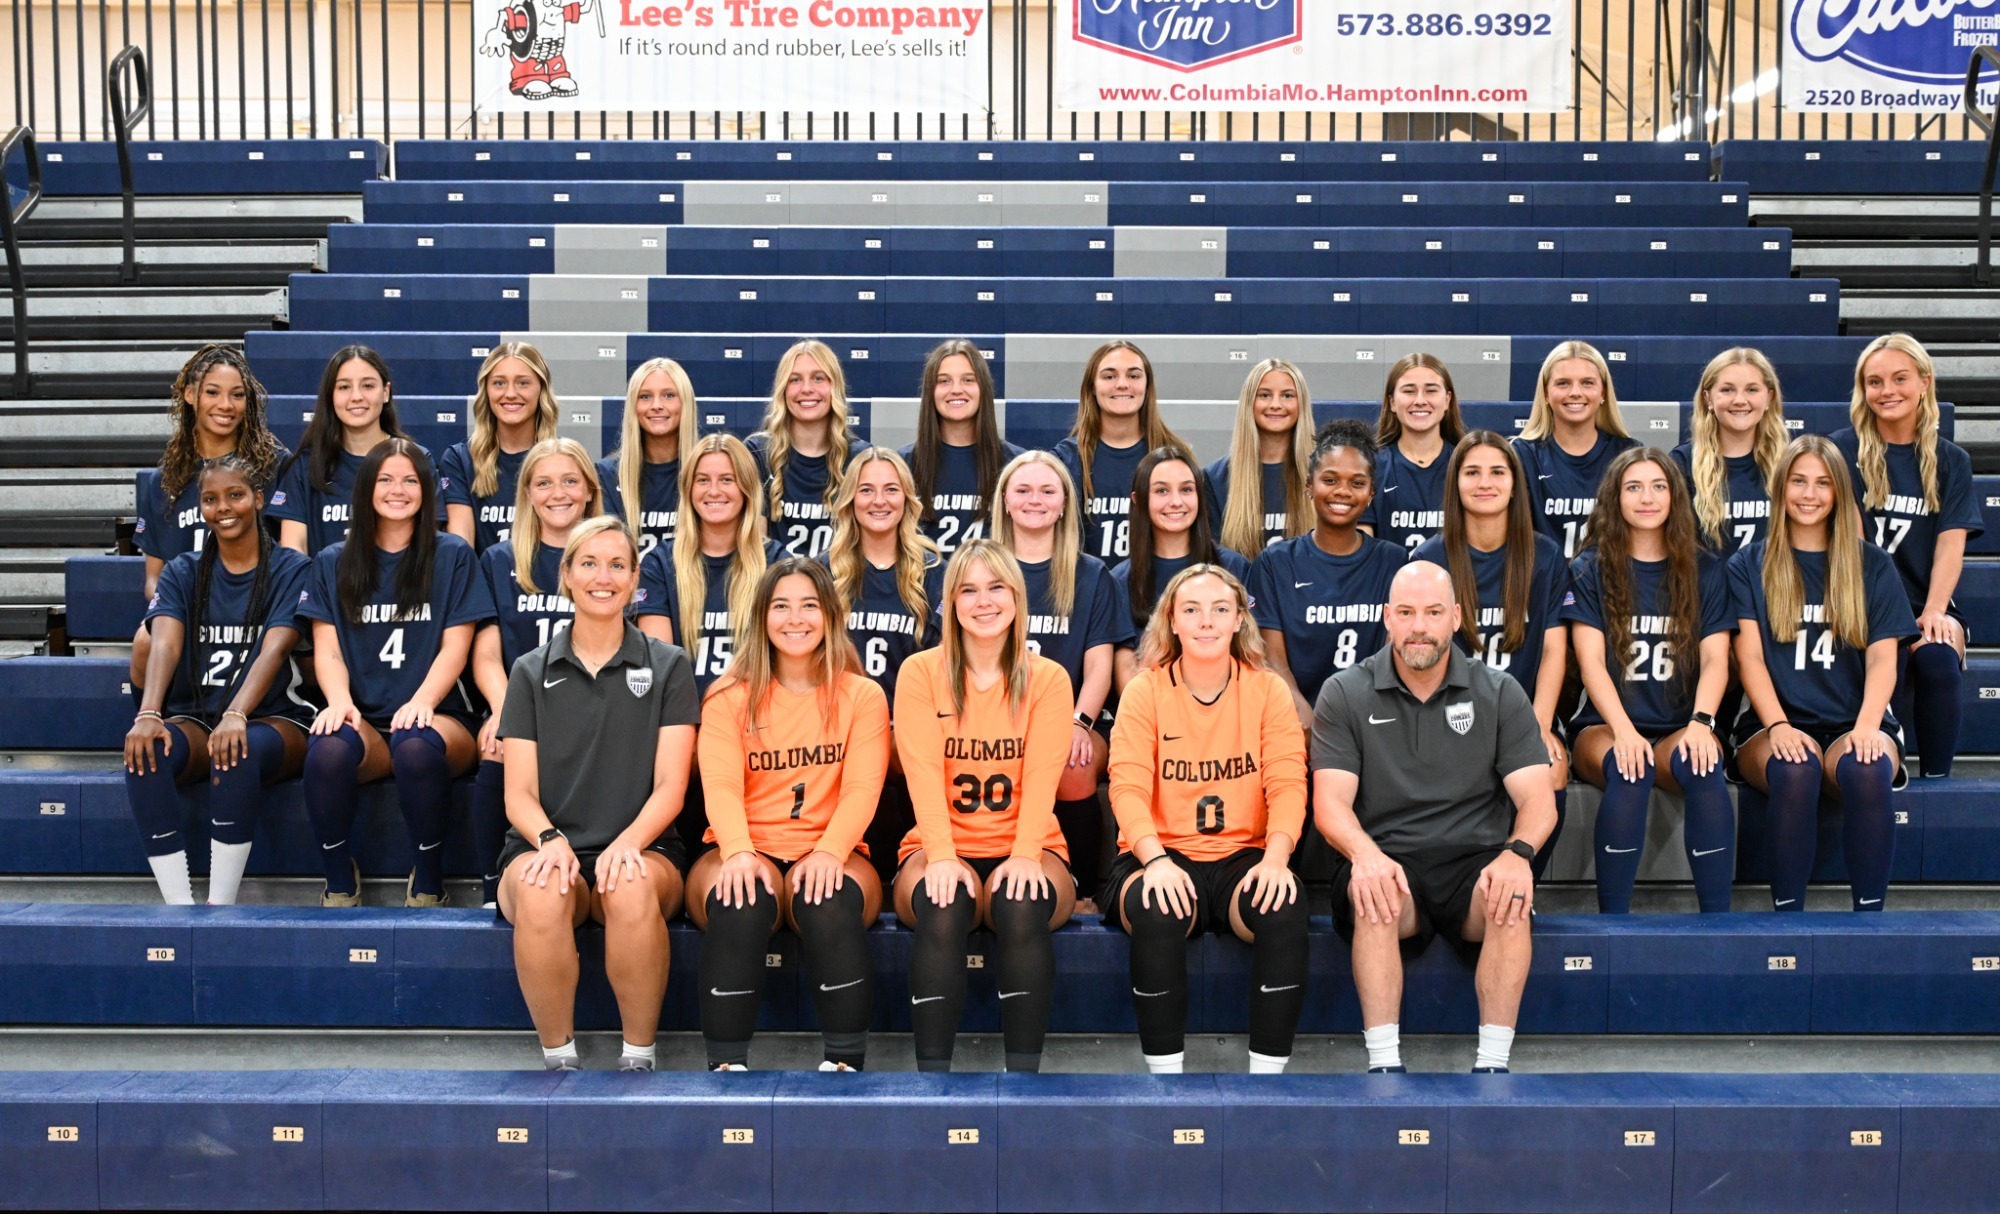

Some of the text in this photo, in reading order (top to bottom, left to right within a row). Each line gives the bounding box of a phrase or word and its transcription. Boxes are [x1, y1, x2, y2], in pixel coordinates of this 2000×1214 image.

[620, 0, 984, 36] Lee's Tire Company
[1138, 5, 1231, 50] Inn
[1337, 13, 1551, 36] 573.886.9392
[619, 37, 966, 58] If it's round and rubber, Lee's sells it!
[1099, 84, 1528, 105] www.ColumbiaMo.HamptonInn.com
[1805, 90, 1855, 106] 2520
[1861, 89, 1961, 110] Broadway
[1545, 498, 1597, 515] COLUM
[1724, 501, 1770, 519] LUMBI
[786, 525, 833, 559] 20
[1101, 520, 1130, 557] 18
[848, 612, 915, 635] OLUMBIA
[379, 628, 406, 669] 4
[695, 636, 735, 676] 15
[865, 636, 889, 677] 6
[1333, 629, 1358, 669] 8
[1625, 640, 1676, 681] 26
[1795, 629, 1836, 670] 14
[748, 743, 843, 772] COLUMBI
[944, 737, 1022, 761] OLUMBI
[790, 783, 806, 820] 1
[952, 773, 1013, 814] 30
[1196, 795, 1225, 836] 0
